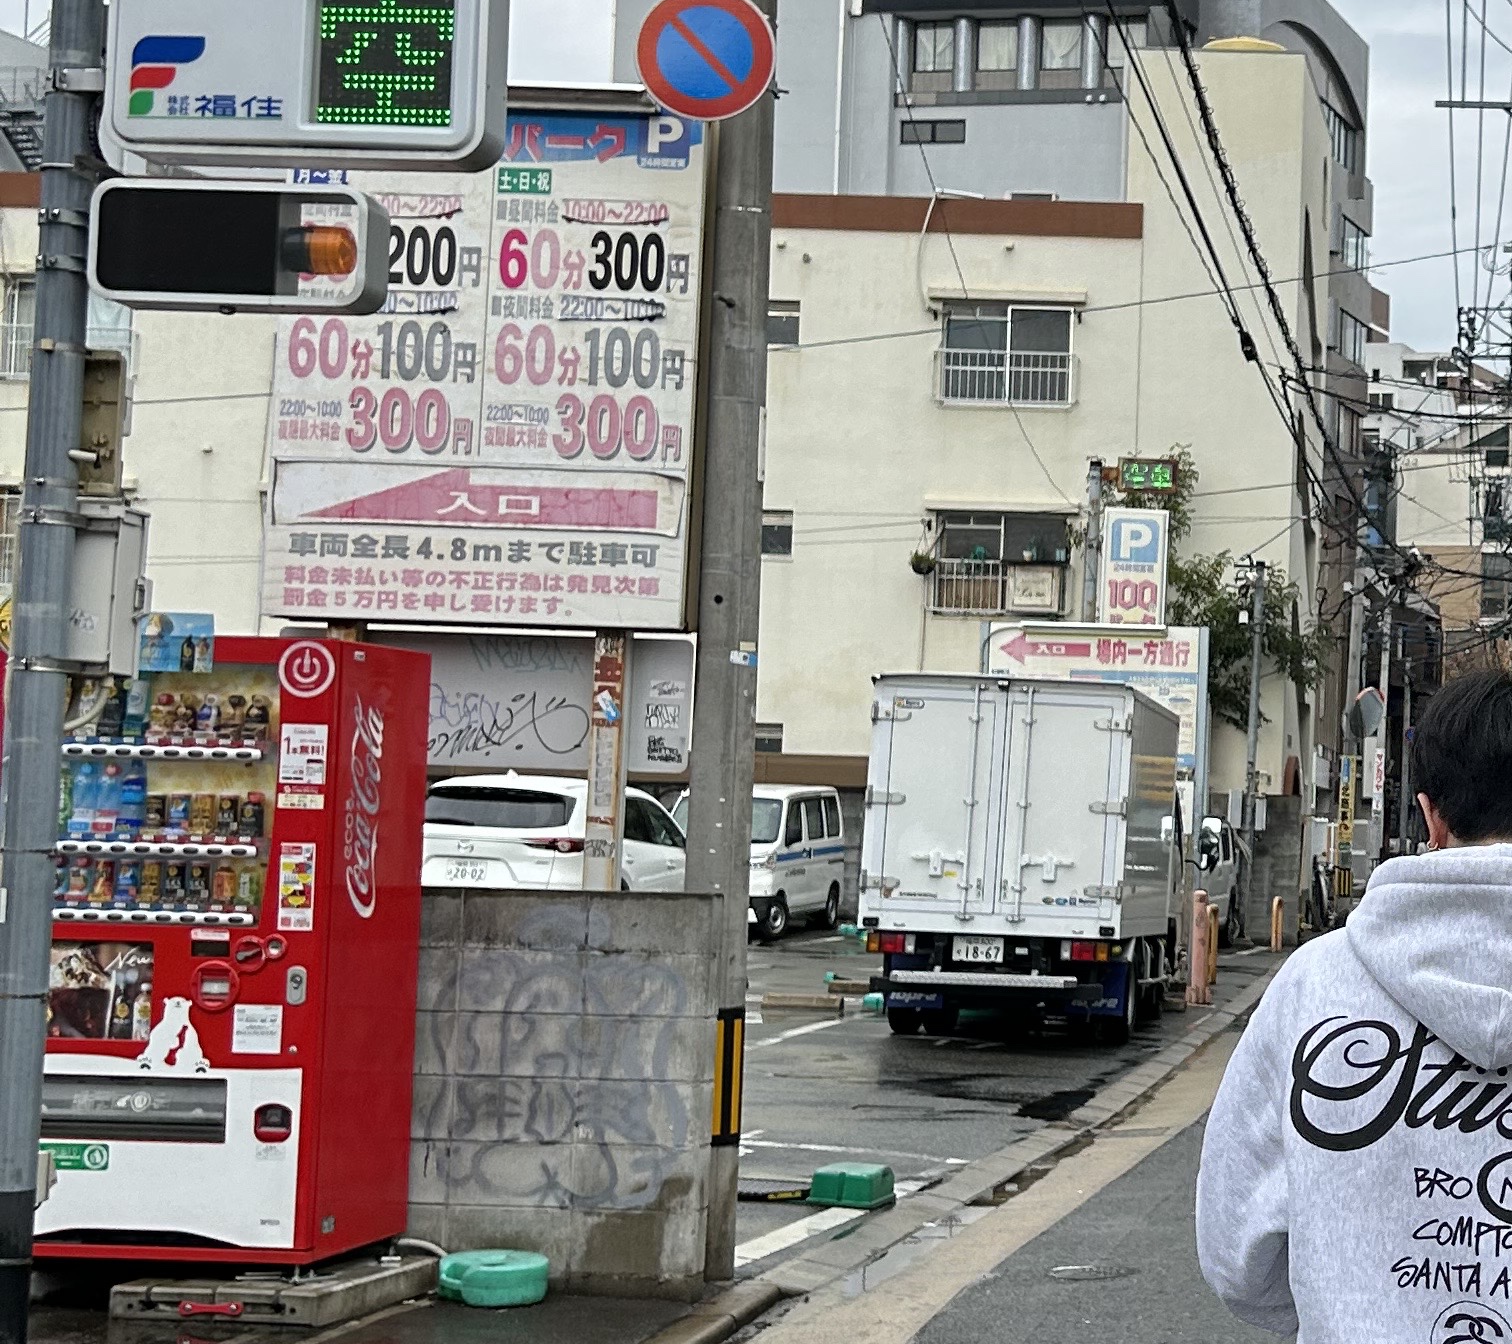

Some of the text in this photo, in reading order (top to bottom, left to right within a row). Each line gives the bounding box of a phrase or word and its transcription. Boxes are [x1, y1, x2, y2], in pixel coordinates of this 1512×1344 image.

[647, 116, 684, 154] P
[436, 492, 542, 517] 入口
[1119, 522, 1153, 560] P
[345, 693, 385, 919] Coca-Cola
[1390, 1256, 1482, 1298] SANTA
